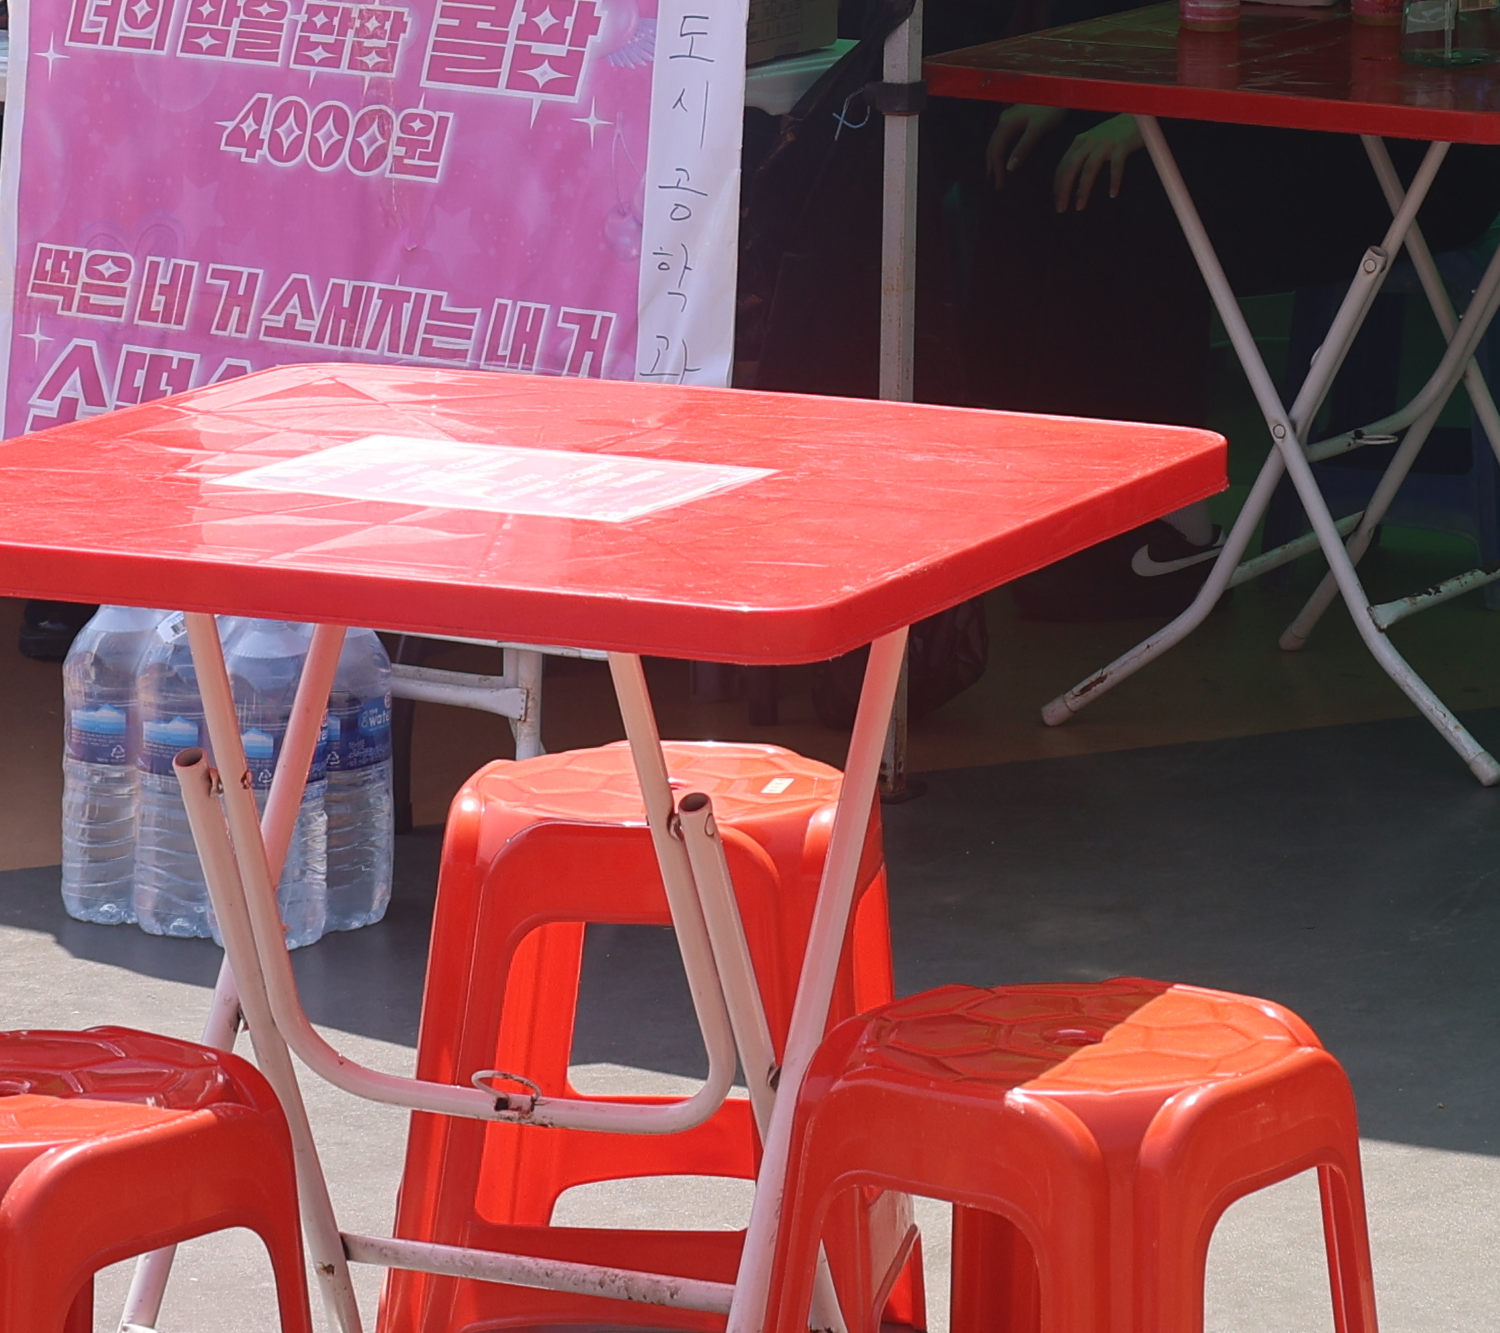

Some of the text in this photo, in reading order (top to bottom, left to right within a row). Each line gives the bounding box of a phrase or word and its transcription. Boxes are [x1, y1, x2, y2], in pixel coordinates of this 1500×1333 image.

[220, 92, 454, 184] 4000원
[28, 242, 618, 379] 떡은 네 거 소세지는 내 거
